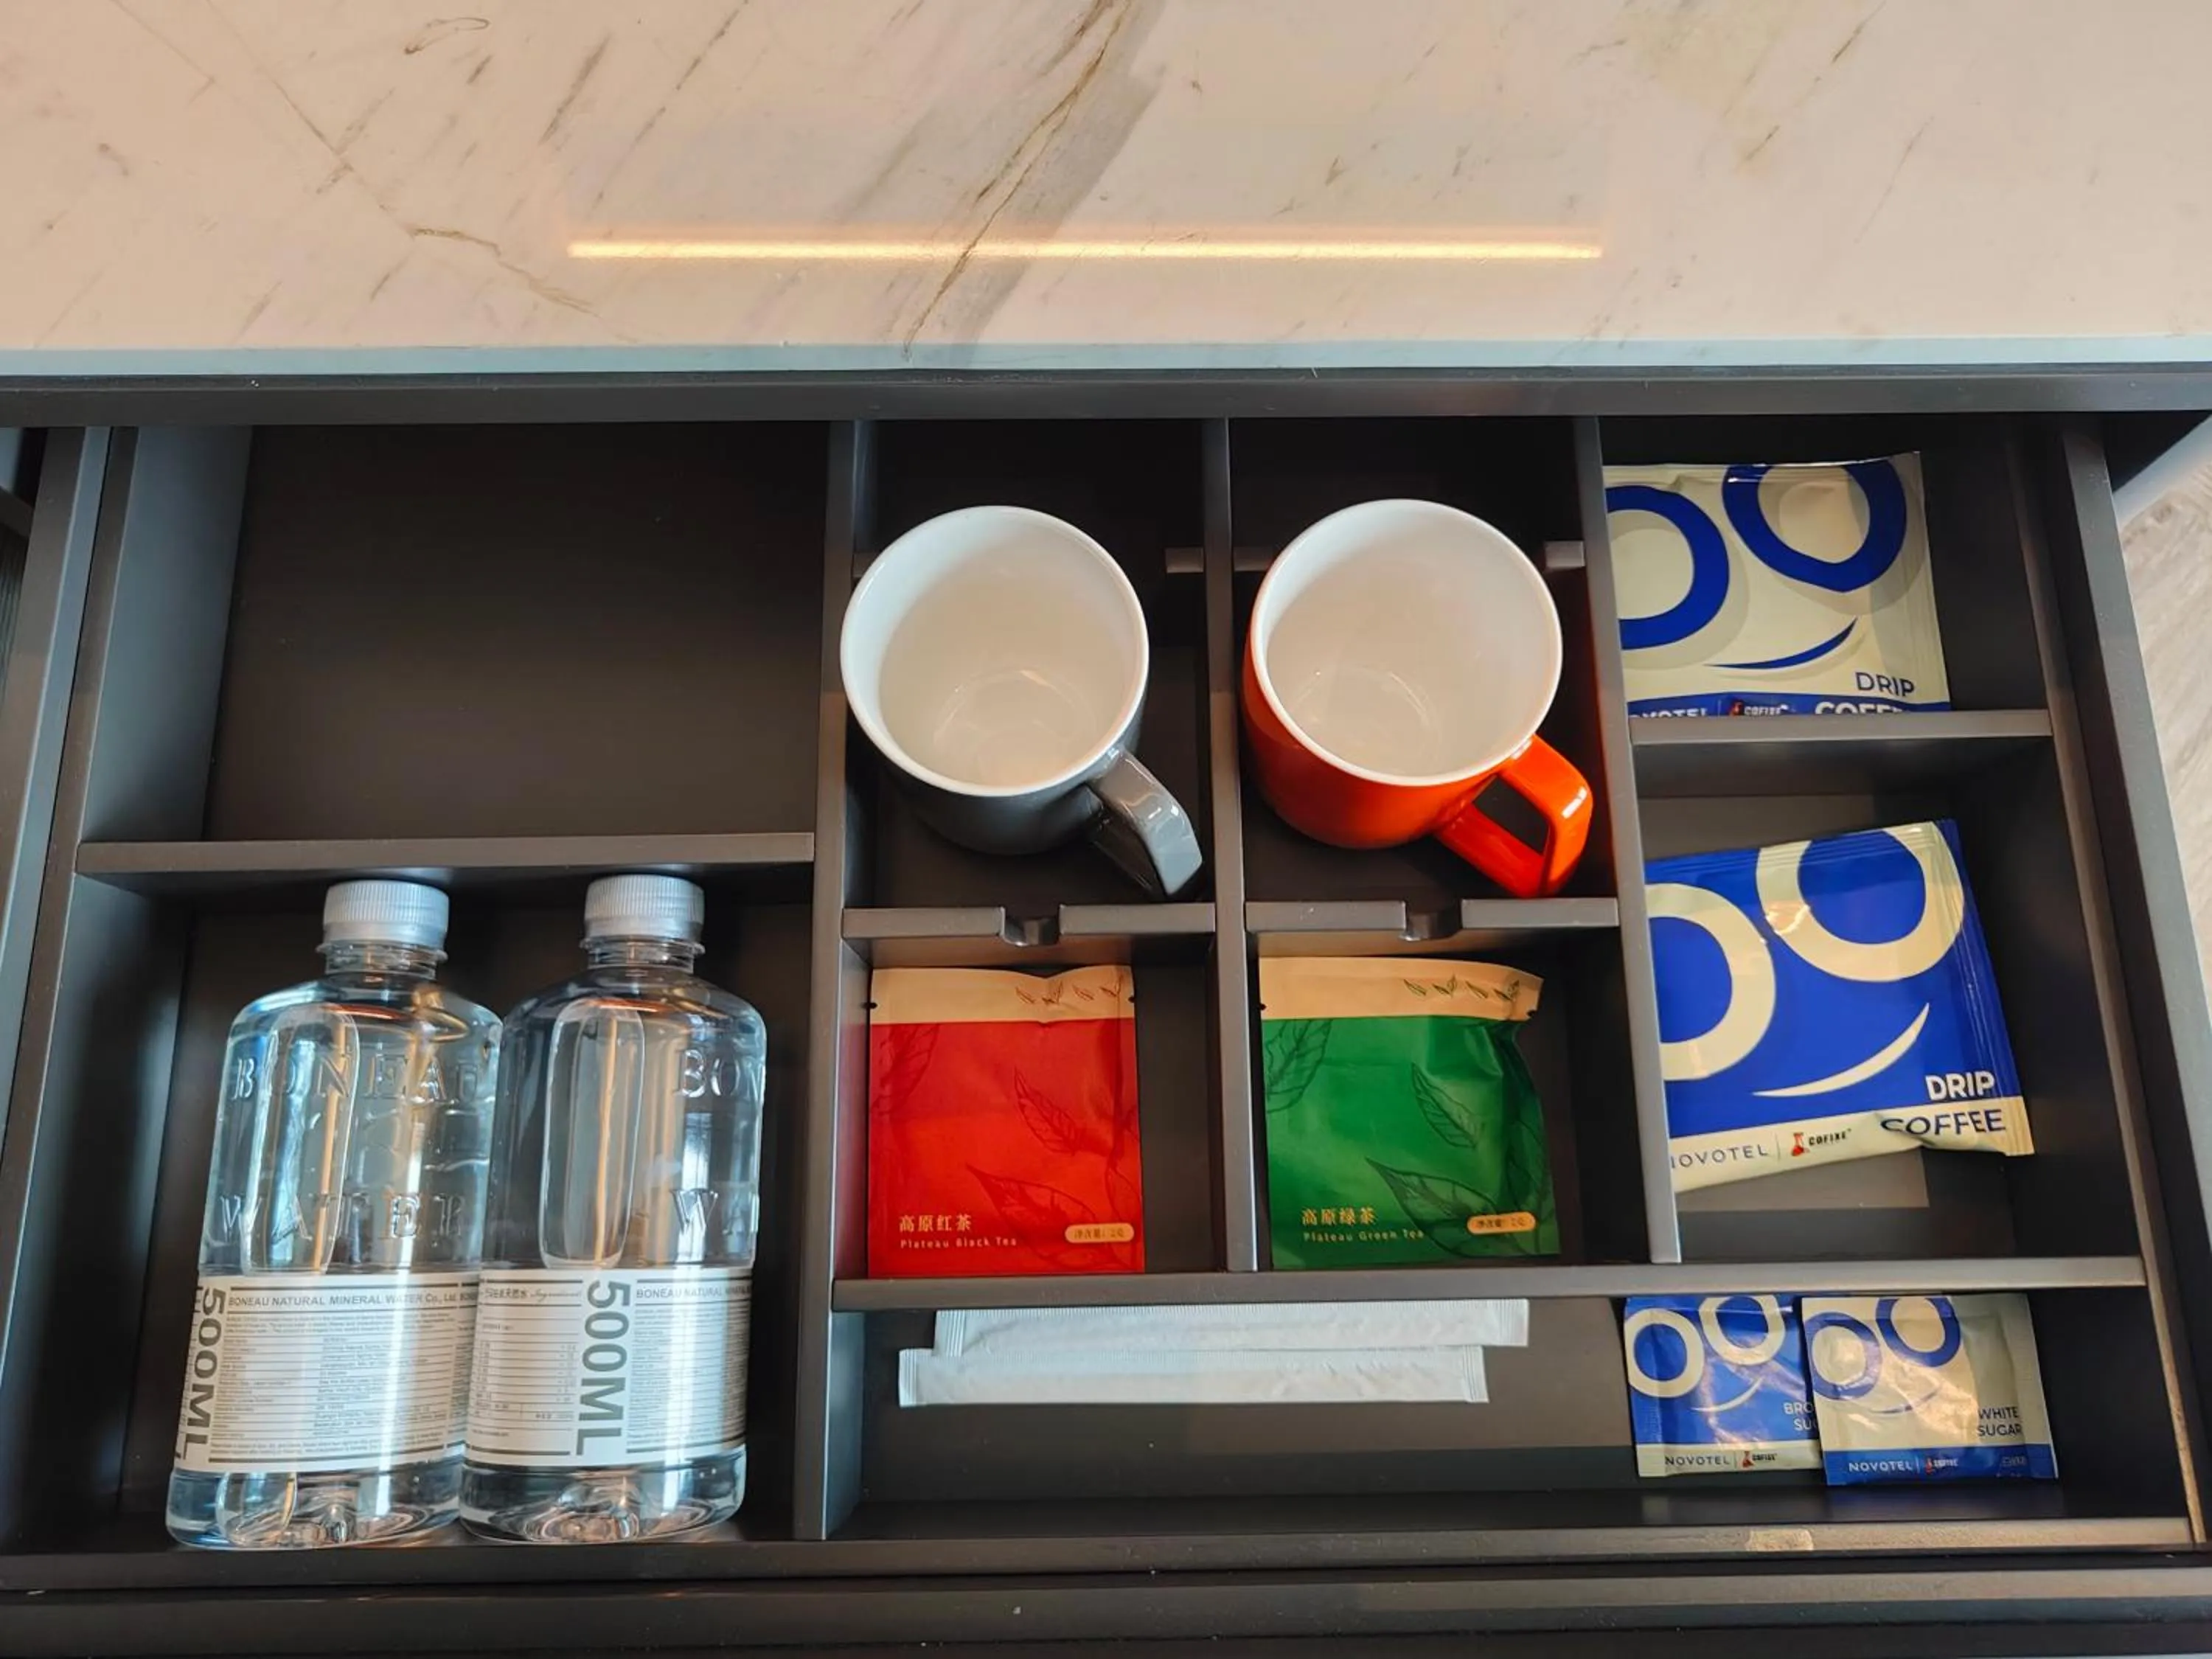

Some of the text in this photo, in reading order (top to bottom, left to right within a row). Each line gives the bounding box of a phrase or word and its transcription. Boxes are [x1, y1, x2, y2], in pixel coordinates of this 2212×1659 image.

[1855, 672, 1915, 697] DRIP
[1925, 1071, 1995, 1100] DRIP
[1880, 1109, 2006, 1135] COFFEE
[1303, 1228, 1425, 1242] Plateau Green Tea
[900, 1237, 1017, 1249] Plateau Black Tea
[229, 1295, 268, 1307] BONEAU
[271, 1294, 325, 1307] NATURAL
[329, 1293, 383, 1305] MINERAL
[636, 1288, 682, 1298] BONEAU
[183, 1287, 226, 1460] 500ML
[576, 1280, 632, 1456] 500ML
[1978, 1407, 2019, 1419] WHITE
[1978, 1423, 2023, 1436] SUGAR
[1665, 1455, 1730, 1466] NOVOTEL
[1848, 1461, 1913, 1472] NOVOTEL
